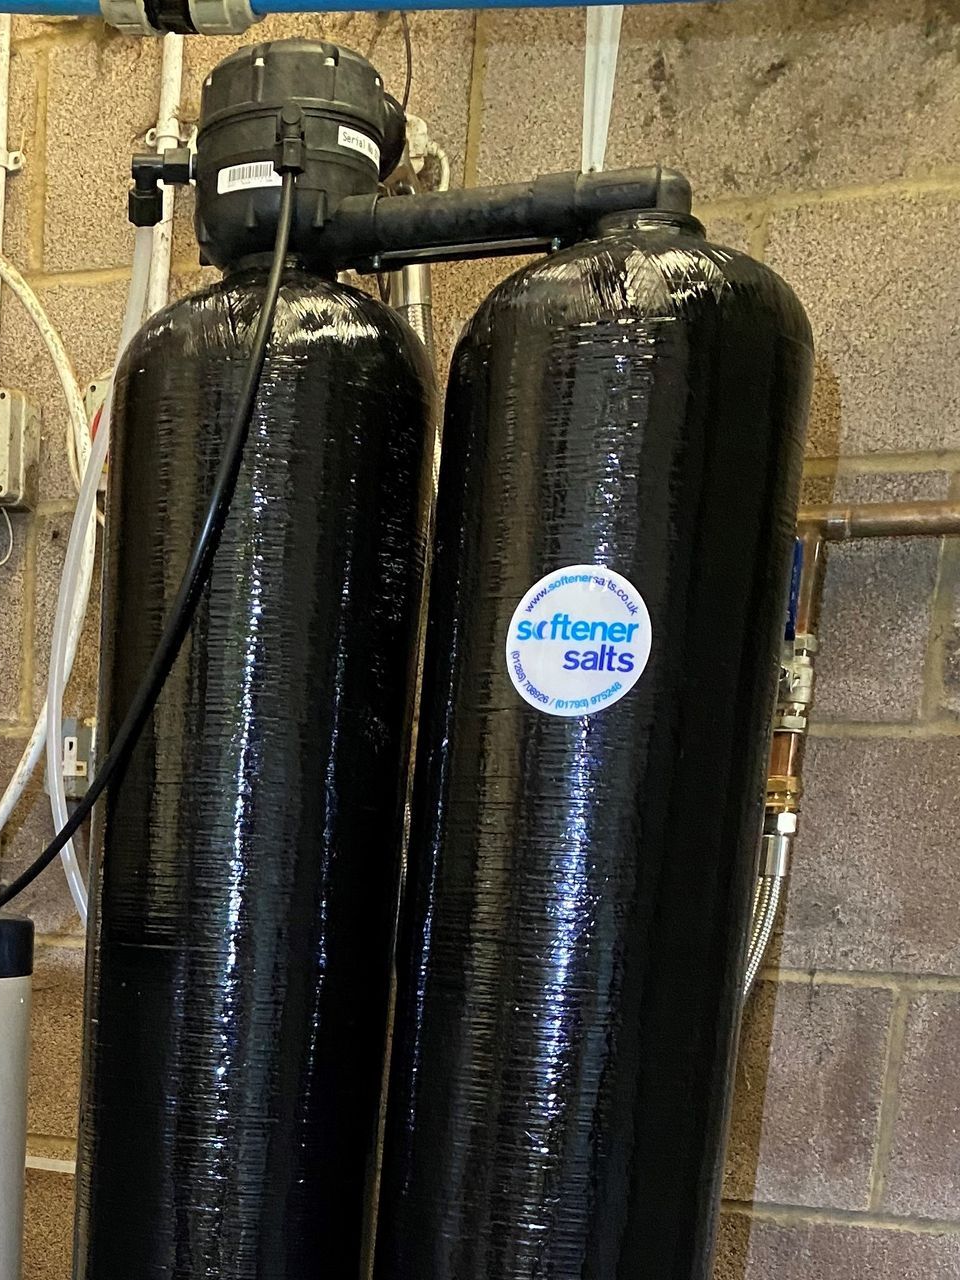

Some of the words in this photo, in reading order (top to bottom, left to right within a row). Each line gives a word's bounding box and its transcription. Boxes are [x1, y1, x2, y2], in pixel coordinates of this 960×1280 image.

[342, 131, 366, 149] Serial
[525, 574, 639, 617] www.softenersats.co.uk
[516, 613, 640, 643] softener
[563, 644, 635, 673] salts
